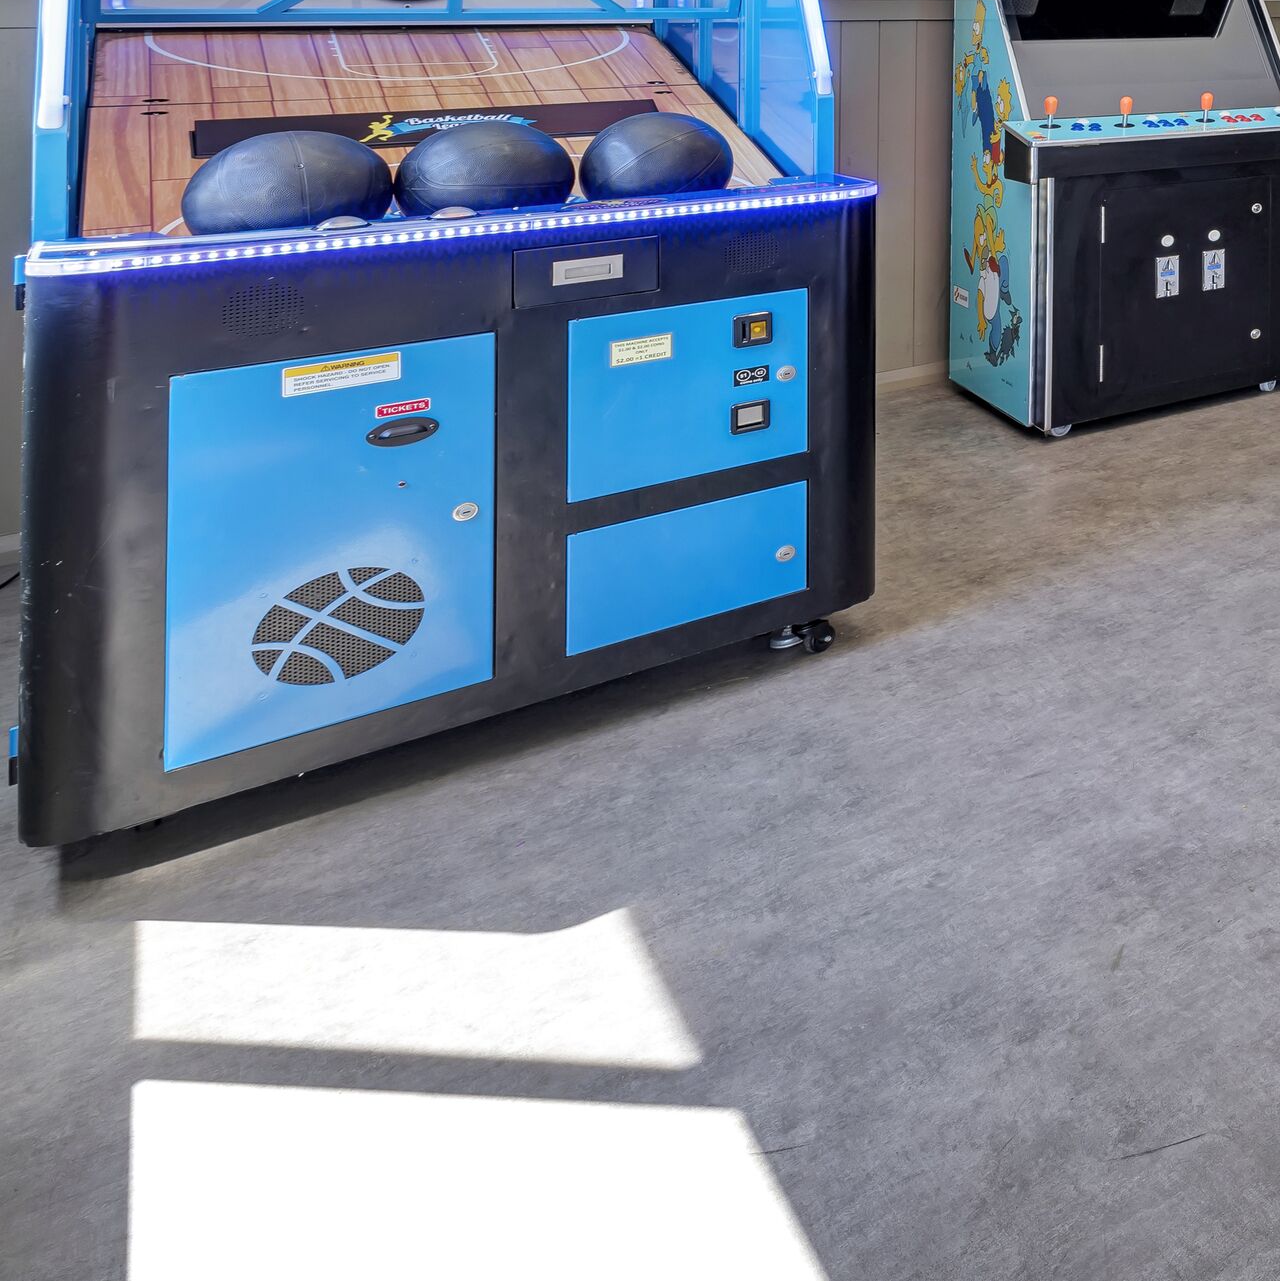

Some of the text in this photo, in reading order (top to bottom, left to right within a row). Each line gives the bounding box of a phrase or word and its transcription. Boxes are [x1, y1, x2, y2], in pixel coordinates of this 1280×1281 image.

[405, 113, 513, 125] Basketball
[645, 351, 666, 359] CREDIT
[330, 361, 365, 370] WARNING
[318, 370, 343, 379] HAZARD
[361, 369, 386, 377] SERVICE
[382, 401, 426, 414] TICKETS
